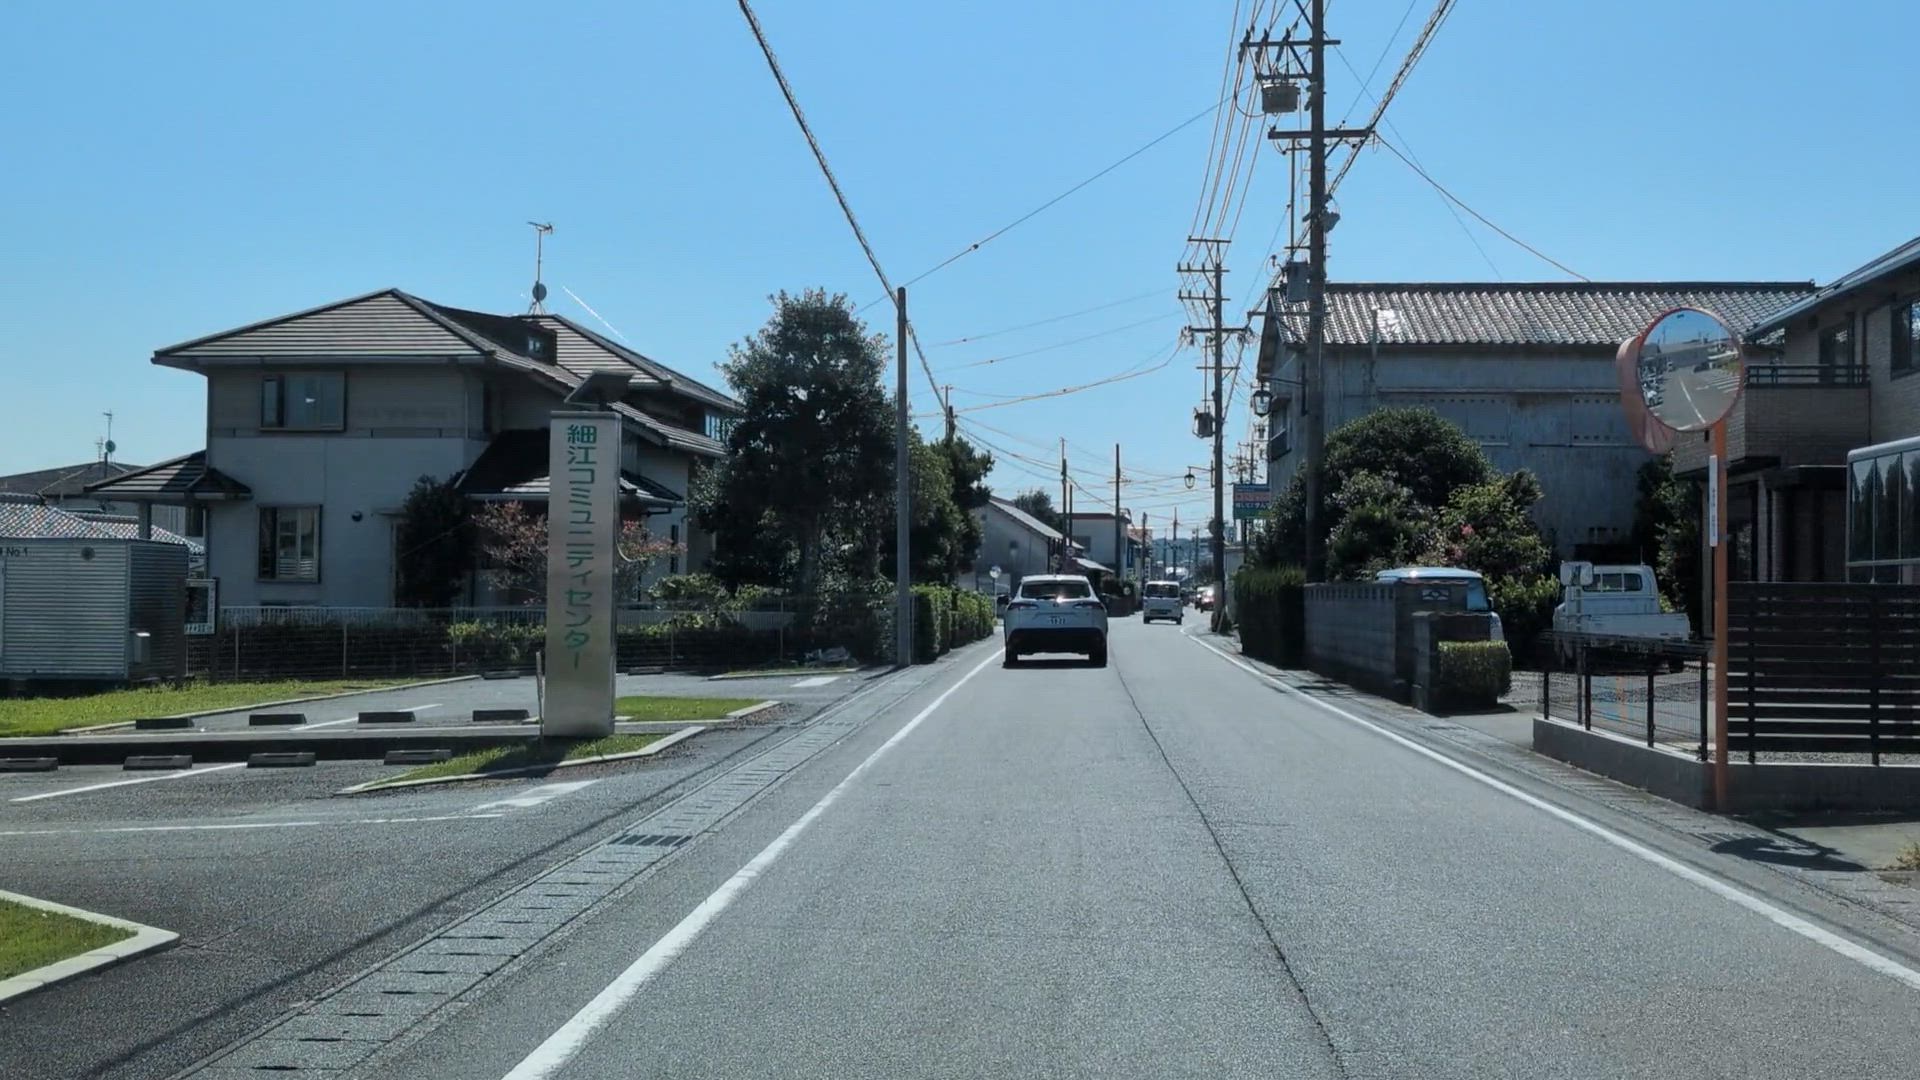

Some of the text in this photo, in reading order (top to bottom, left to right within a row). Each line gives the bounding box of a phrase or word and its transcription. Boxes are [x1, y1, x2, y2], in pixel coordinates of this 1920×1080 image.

[565, 423, 597, 669] 細江コミュニティセンター
